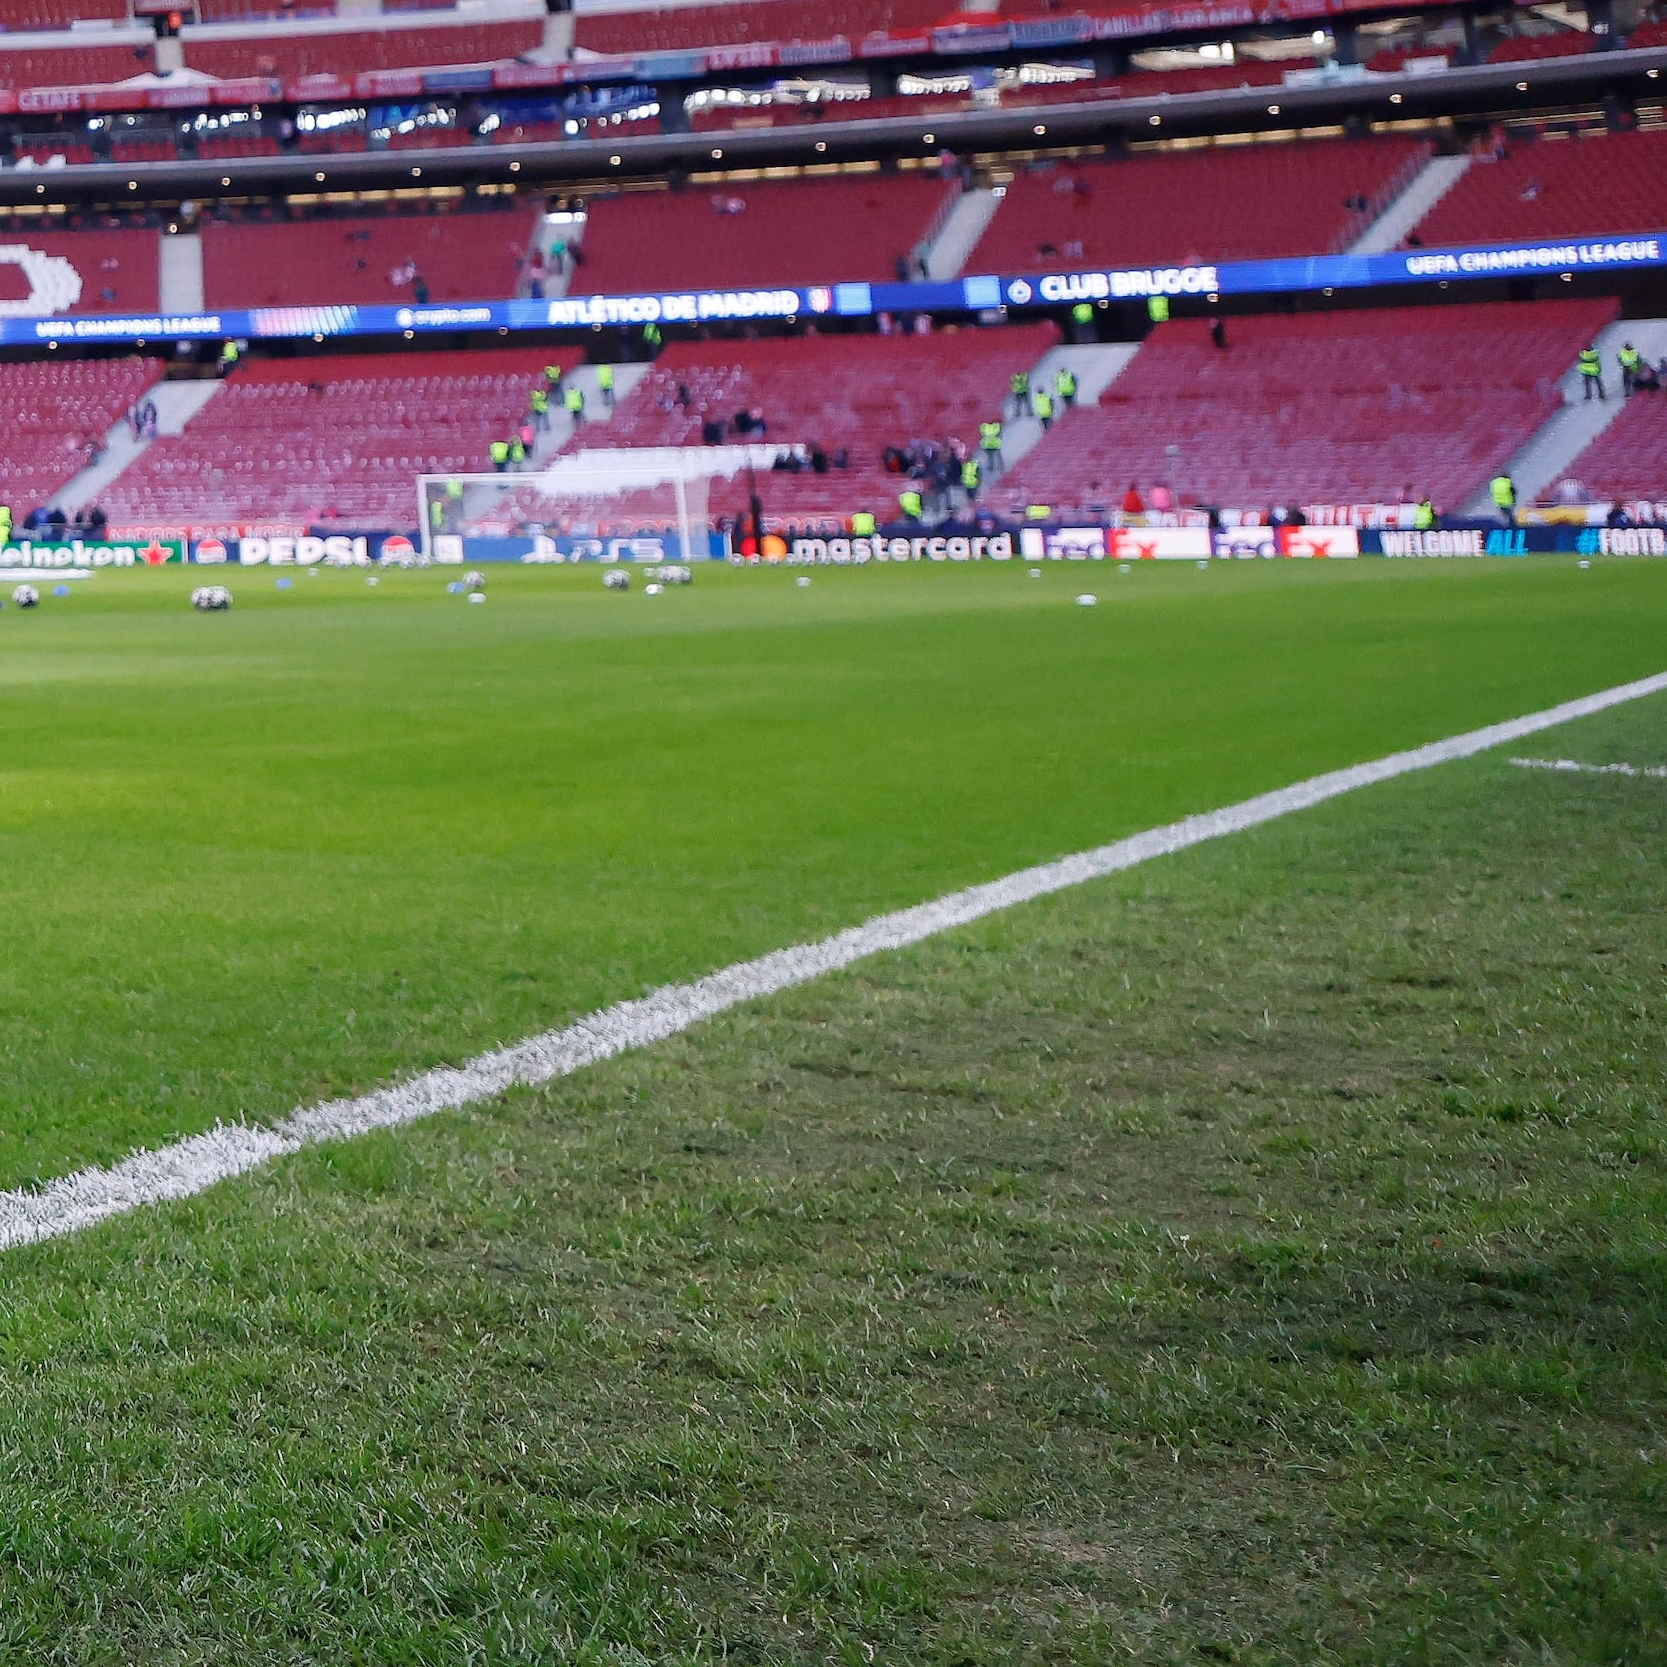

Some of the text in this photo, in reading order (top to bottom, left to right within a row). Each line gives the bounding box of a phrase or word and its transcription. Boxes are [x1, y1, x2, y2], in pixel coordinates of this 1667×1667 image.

[1405, 240, 1660, 274] UEFA CHAMPIONS LEAGUE
[1039, 266, 1218, 301] CLUB BRUGGE
[548, 289, 800, 324] ATLÉTICO DE MADRID
[239, 535, 369, 567] PEPSI
[793, 532, 1013, 564] mastercard
[1485, 529, 1529, 557] ALL
